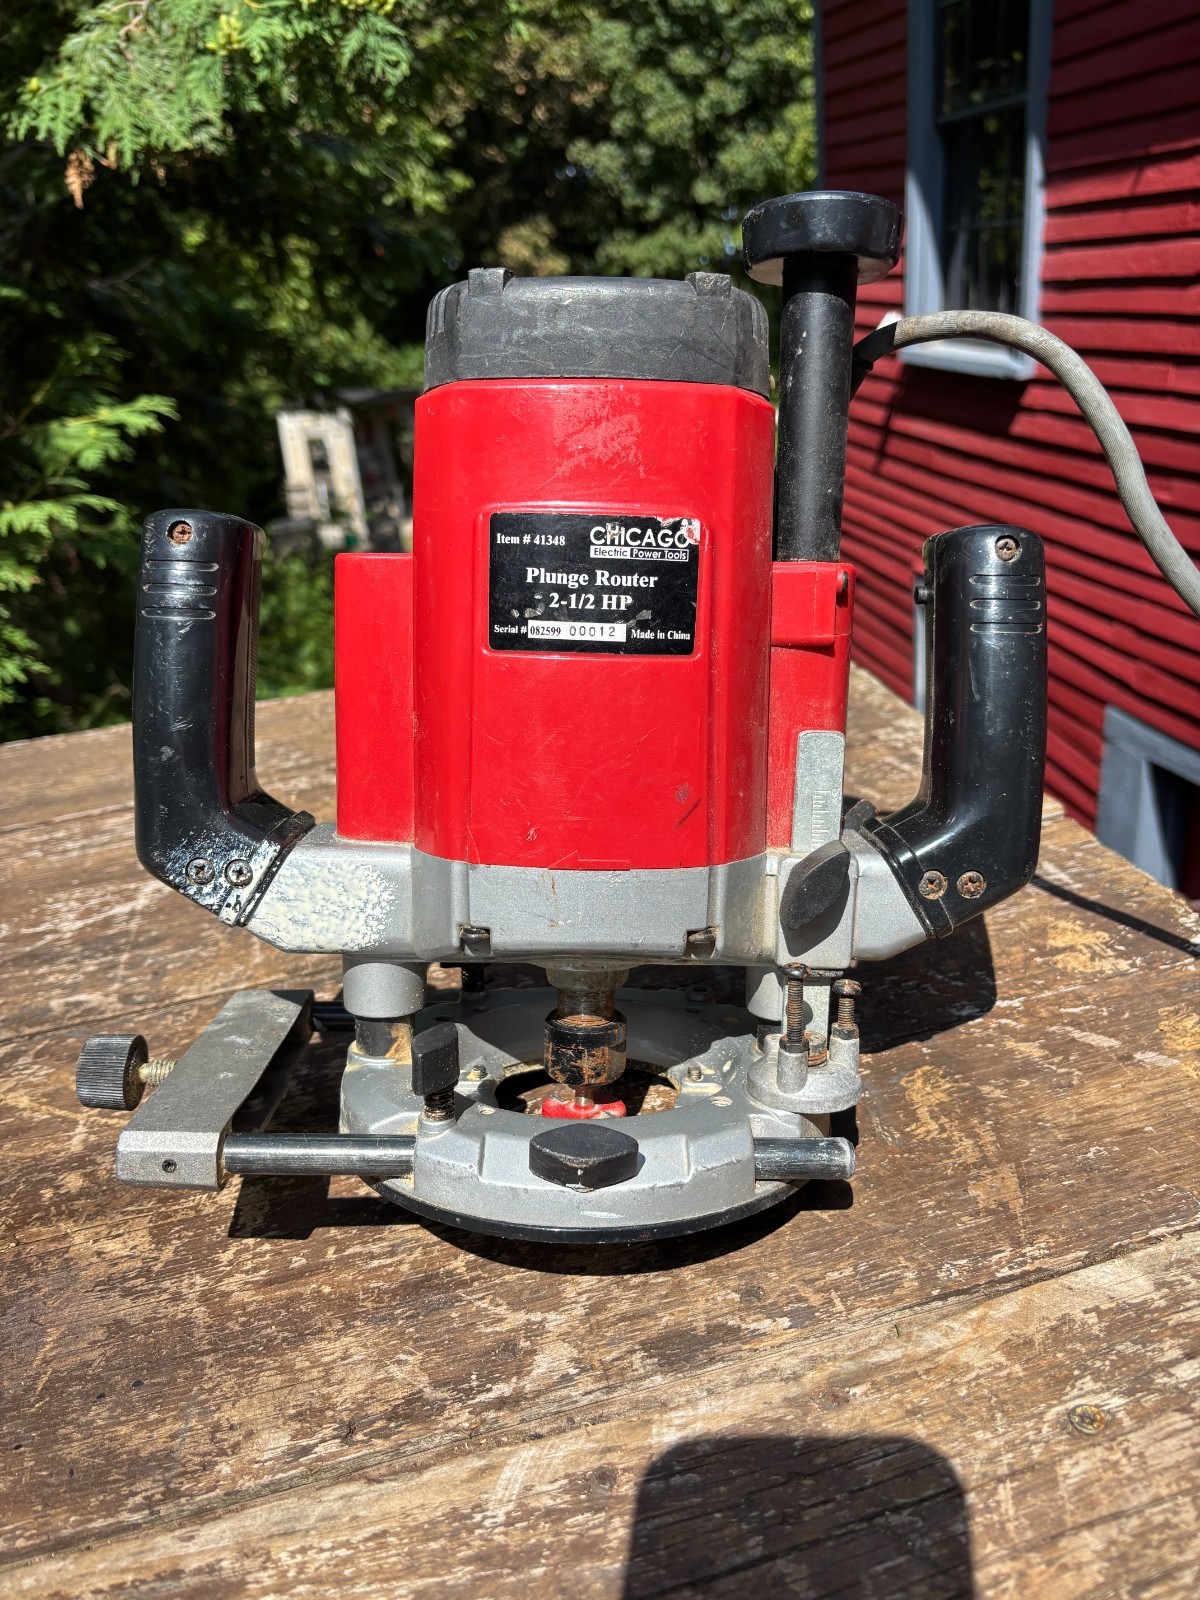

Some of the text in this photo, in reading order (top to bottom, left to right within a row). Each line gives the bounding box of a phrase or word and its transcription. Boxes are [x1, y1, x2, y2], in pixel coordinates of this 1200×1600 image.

[496, 533, 566, 546] Item # 41348
[589, 525, 690, 548] CHICAGO
[593, 547, 687, 560] Electric Power Tools
[525, 567, 659, 589] Plunge Router
[549, 592, 633, 611] 2-1/2 HP
[493, 625, 616, 637] Serial # 082599 00012
[630, 629, 691, 641] Made in China
